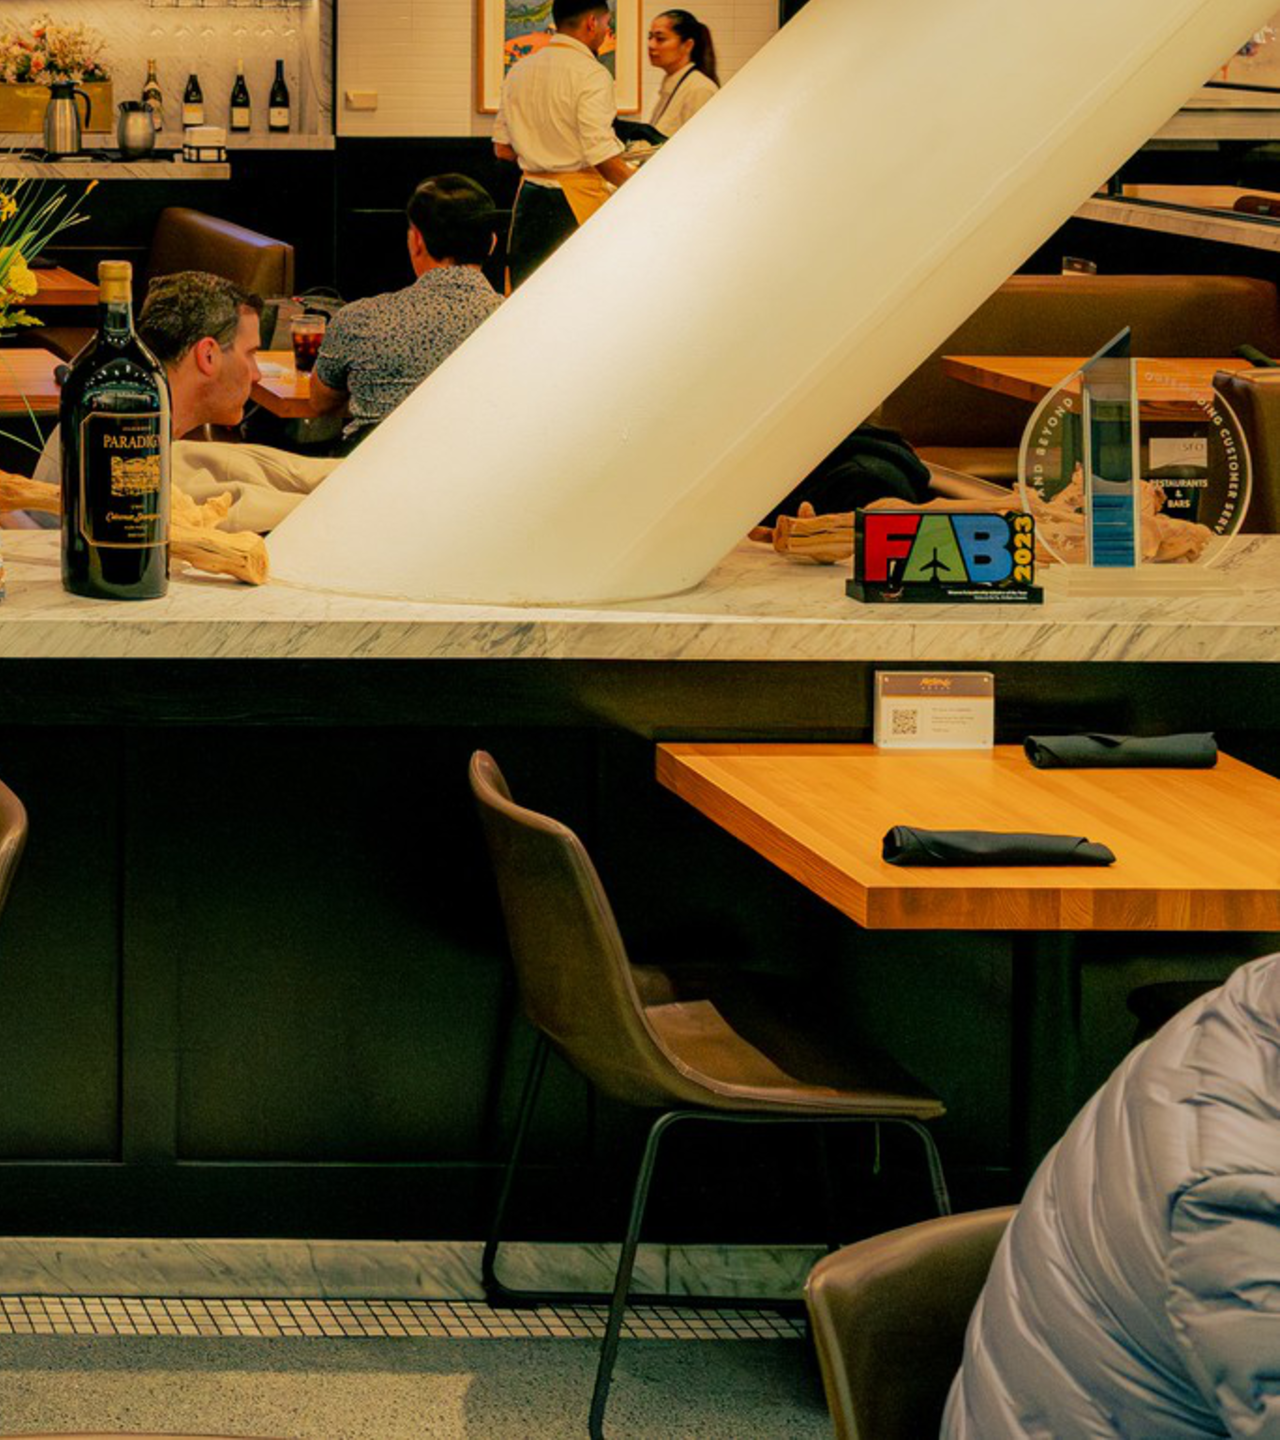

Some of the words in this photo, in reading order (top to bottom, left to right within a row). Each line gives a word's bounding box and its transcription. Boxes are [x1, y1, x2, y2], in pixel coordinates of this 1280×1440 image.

[1036, 396, 1074, 457] BEYOND
[1219, 426, 1241, 500] CUSTOMER
[1167, 499, 1191, 509] BARS
[1174, 489, 1184, 499] &
[864, 513, 1014, 583] FAB
[1013, 515, 1035, 583] 2023
